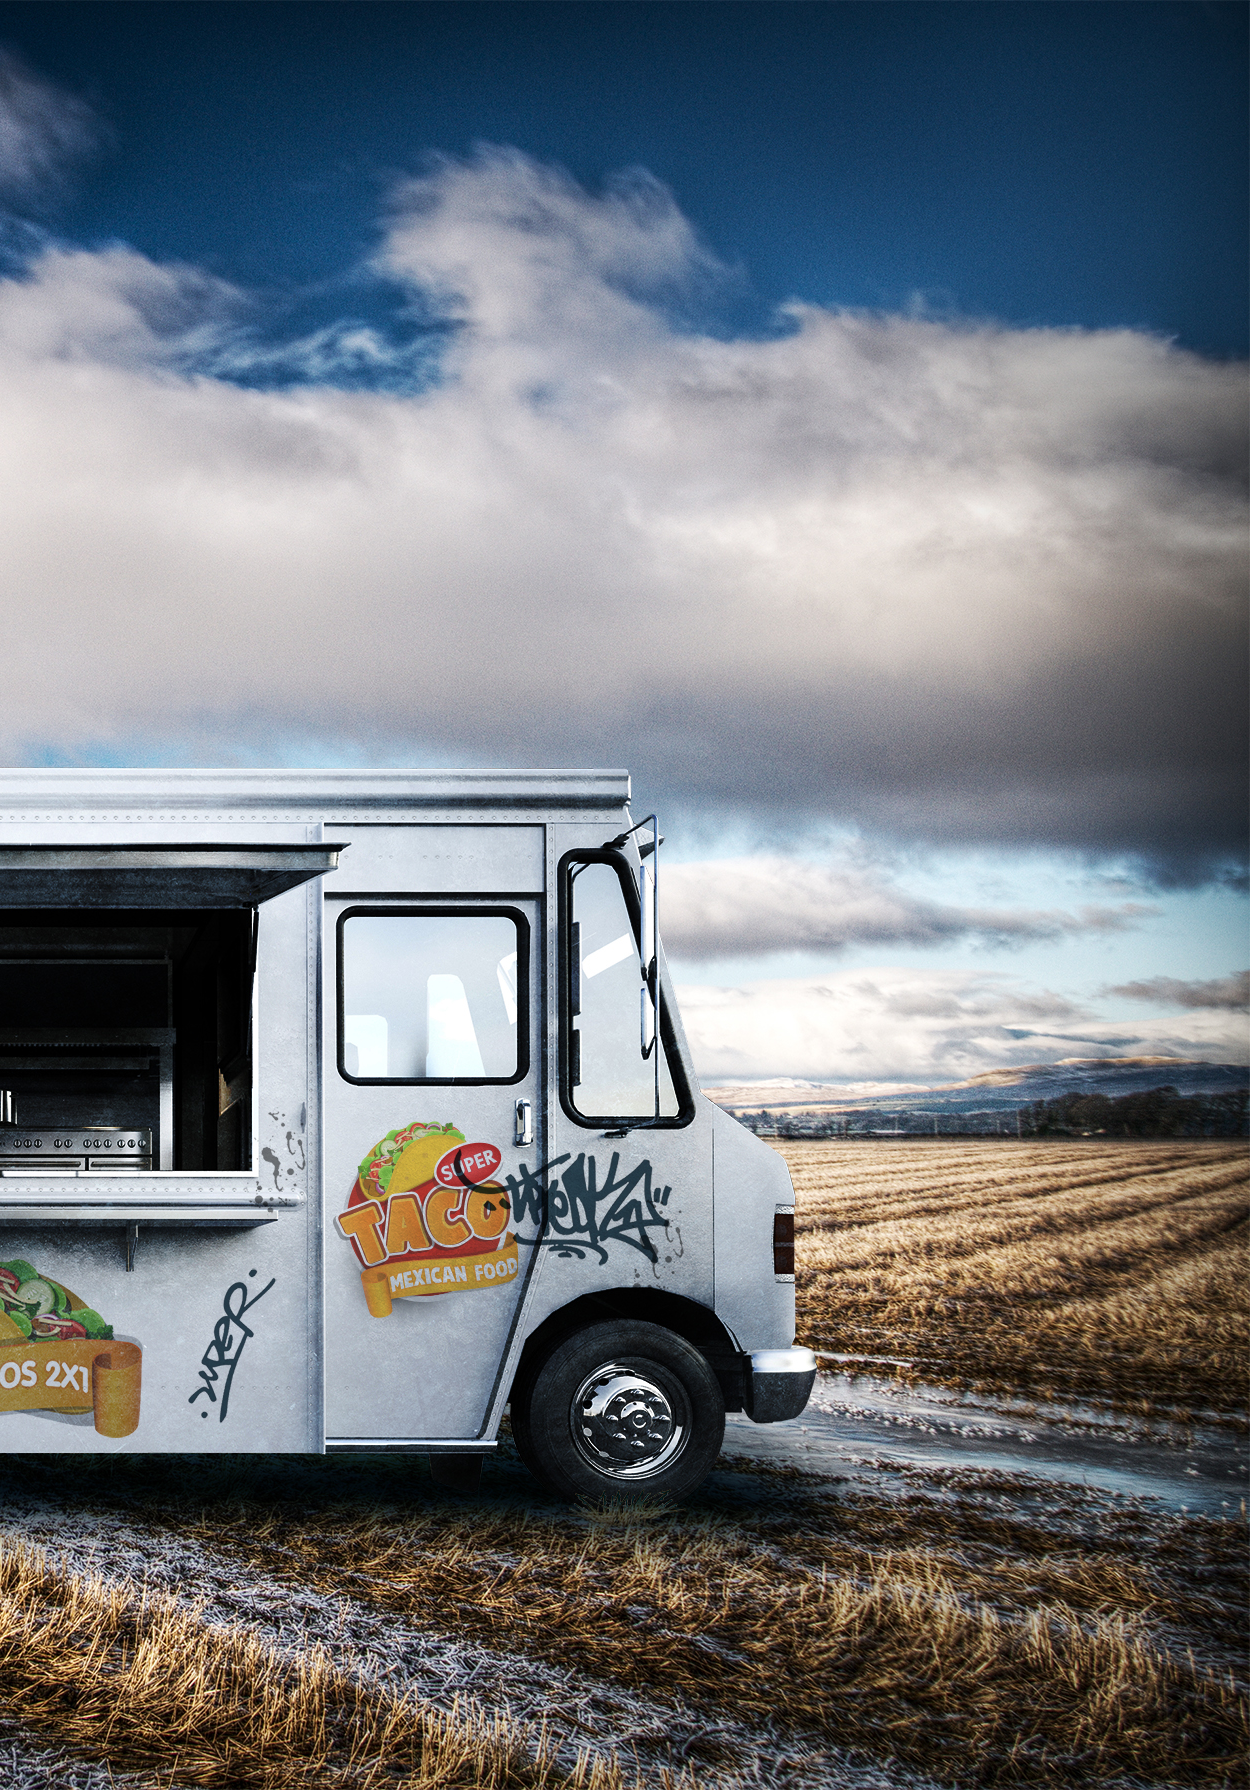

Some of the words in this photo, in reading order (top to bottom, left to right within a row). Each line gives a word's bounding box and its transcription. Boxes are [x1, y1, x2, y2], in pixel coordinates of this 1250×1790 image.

[440, 1149, 498, 1181] SUPER
[338, 1181, 511, 1267] TACO
[389, 1265, 468, 1293] MEXICAN
[474, 1257, 518, 1281] FOOD
[45, 1360, 89, 1394] 2X1
